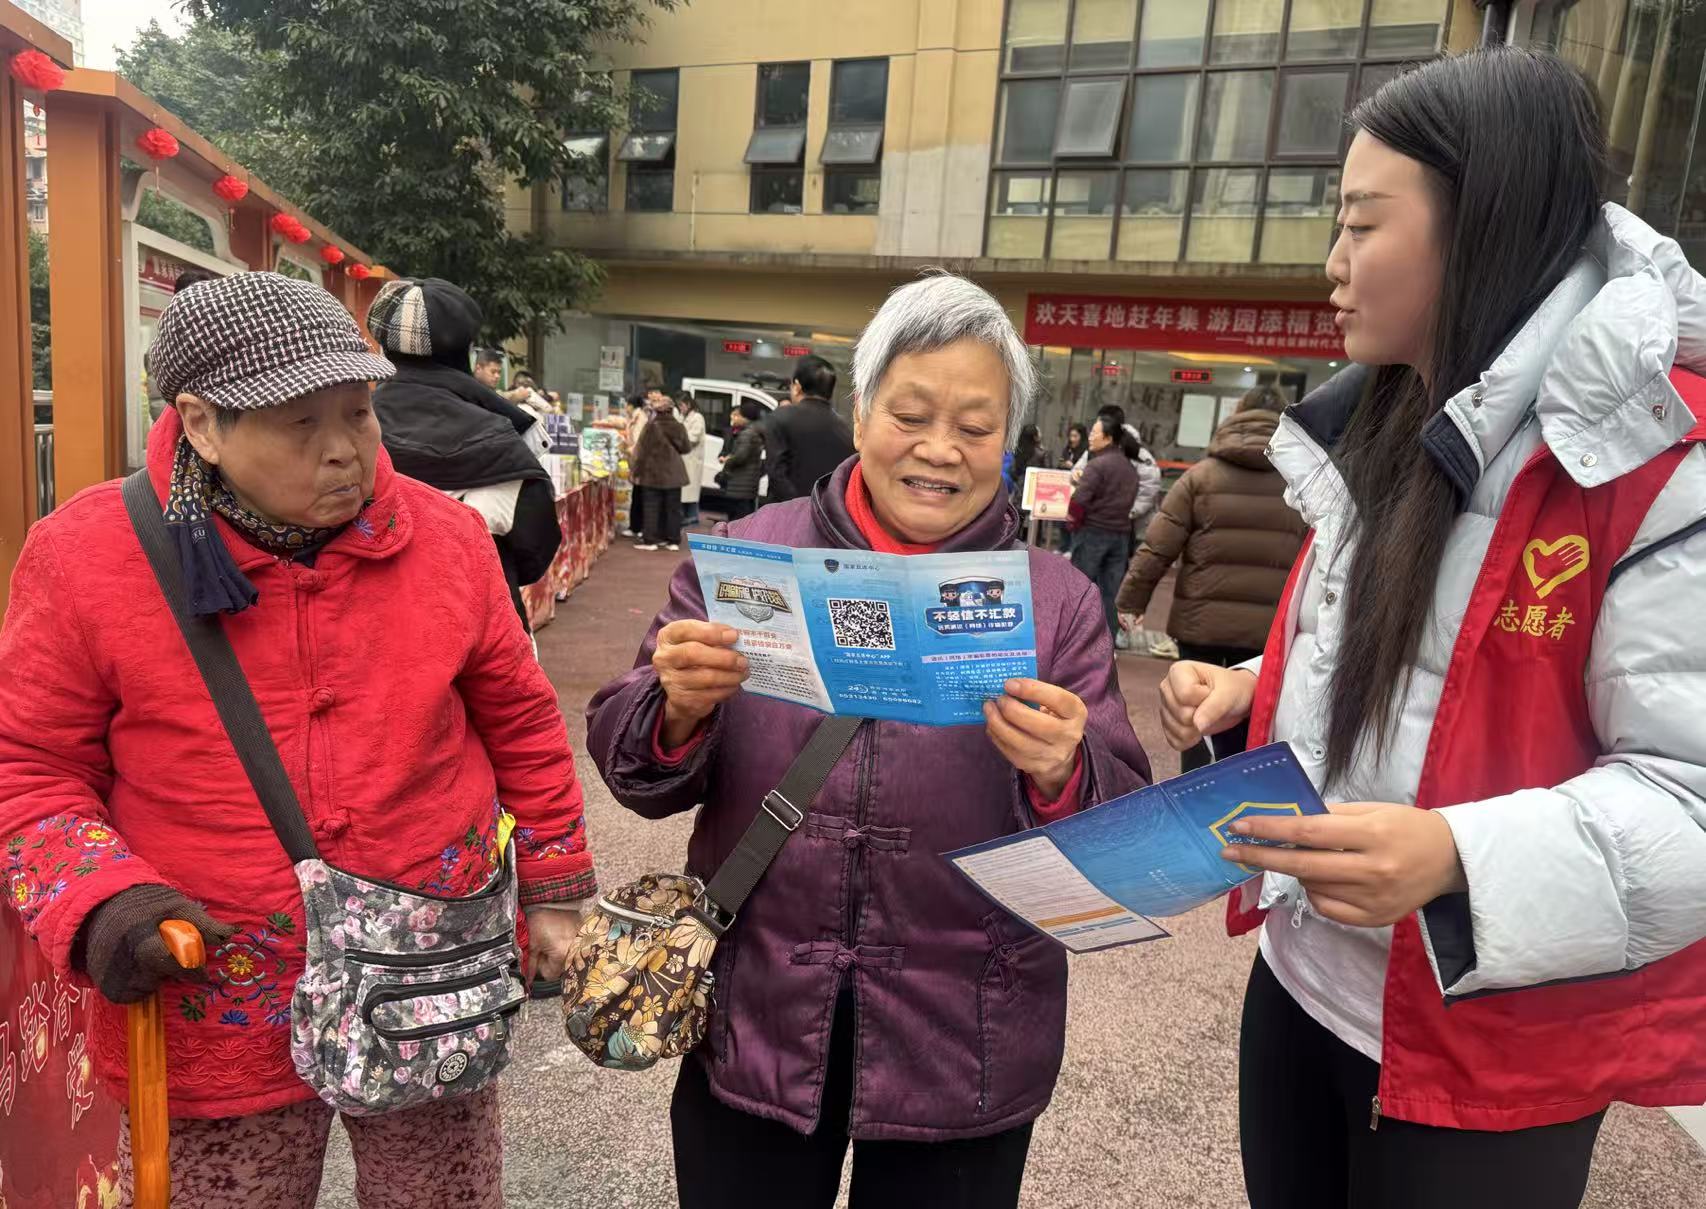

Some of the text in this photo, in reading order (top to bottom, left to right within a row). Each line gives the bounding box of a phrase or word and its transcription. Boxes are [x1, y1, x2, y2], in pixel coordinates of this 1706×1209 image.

[1035, 302, 1345, 336] 欢天喜地赶年集 游园添福贺
[932, 607, 1017, 622] 不轻信不汇款
[1493, 599, 1576, 641] 志愿者
